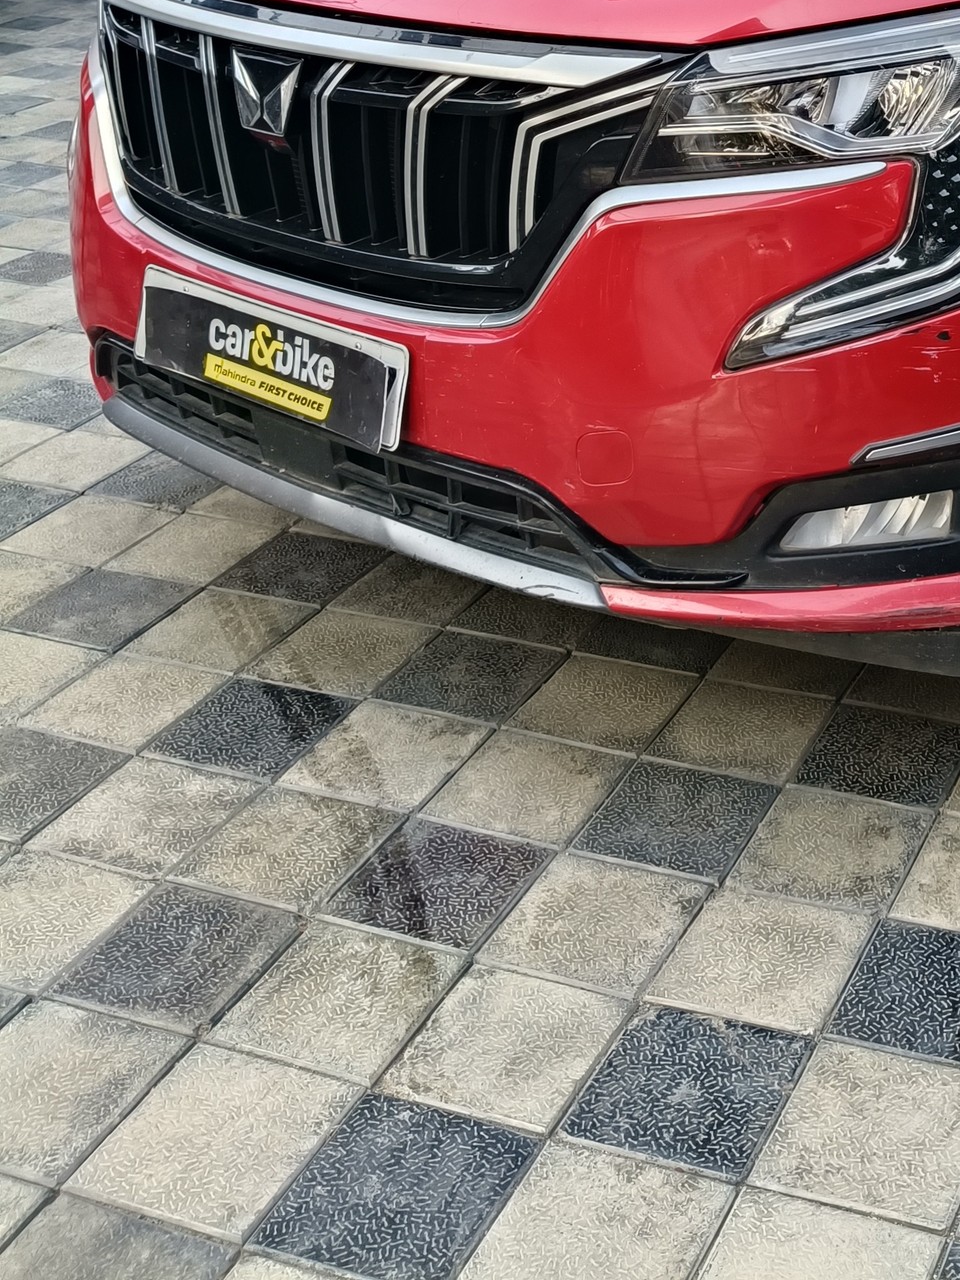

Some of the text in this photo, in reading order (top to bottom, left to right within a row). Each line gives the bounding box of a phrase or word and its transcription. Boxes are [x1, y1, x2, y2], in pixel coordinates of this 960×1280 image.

[208, 318, 335, 391] car&bike
[258, 380, 288, 399] FIRST
[288, 391, 325, 413] CHOICE
